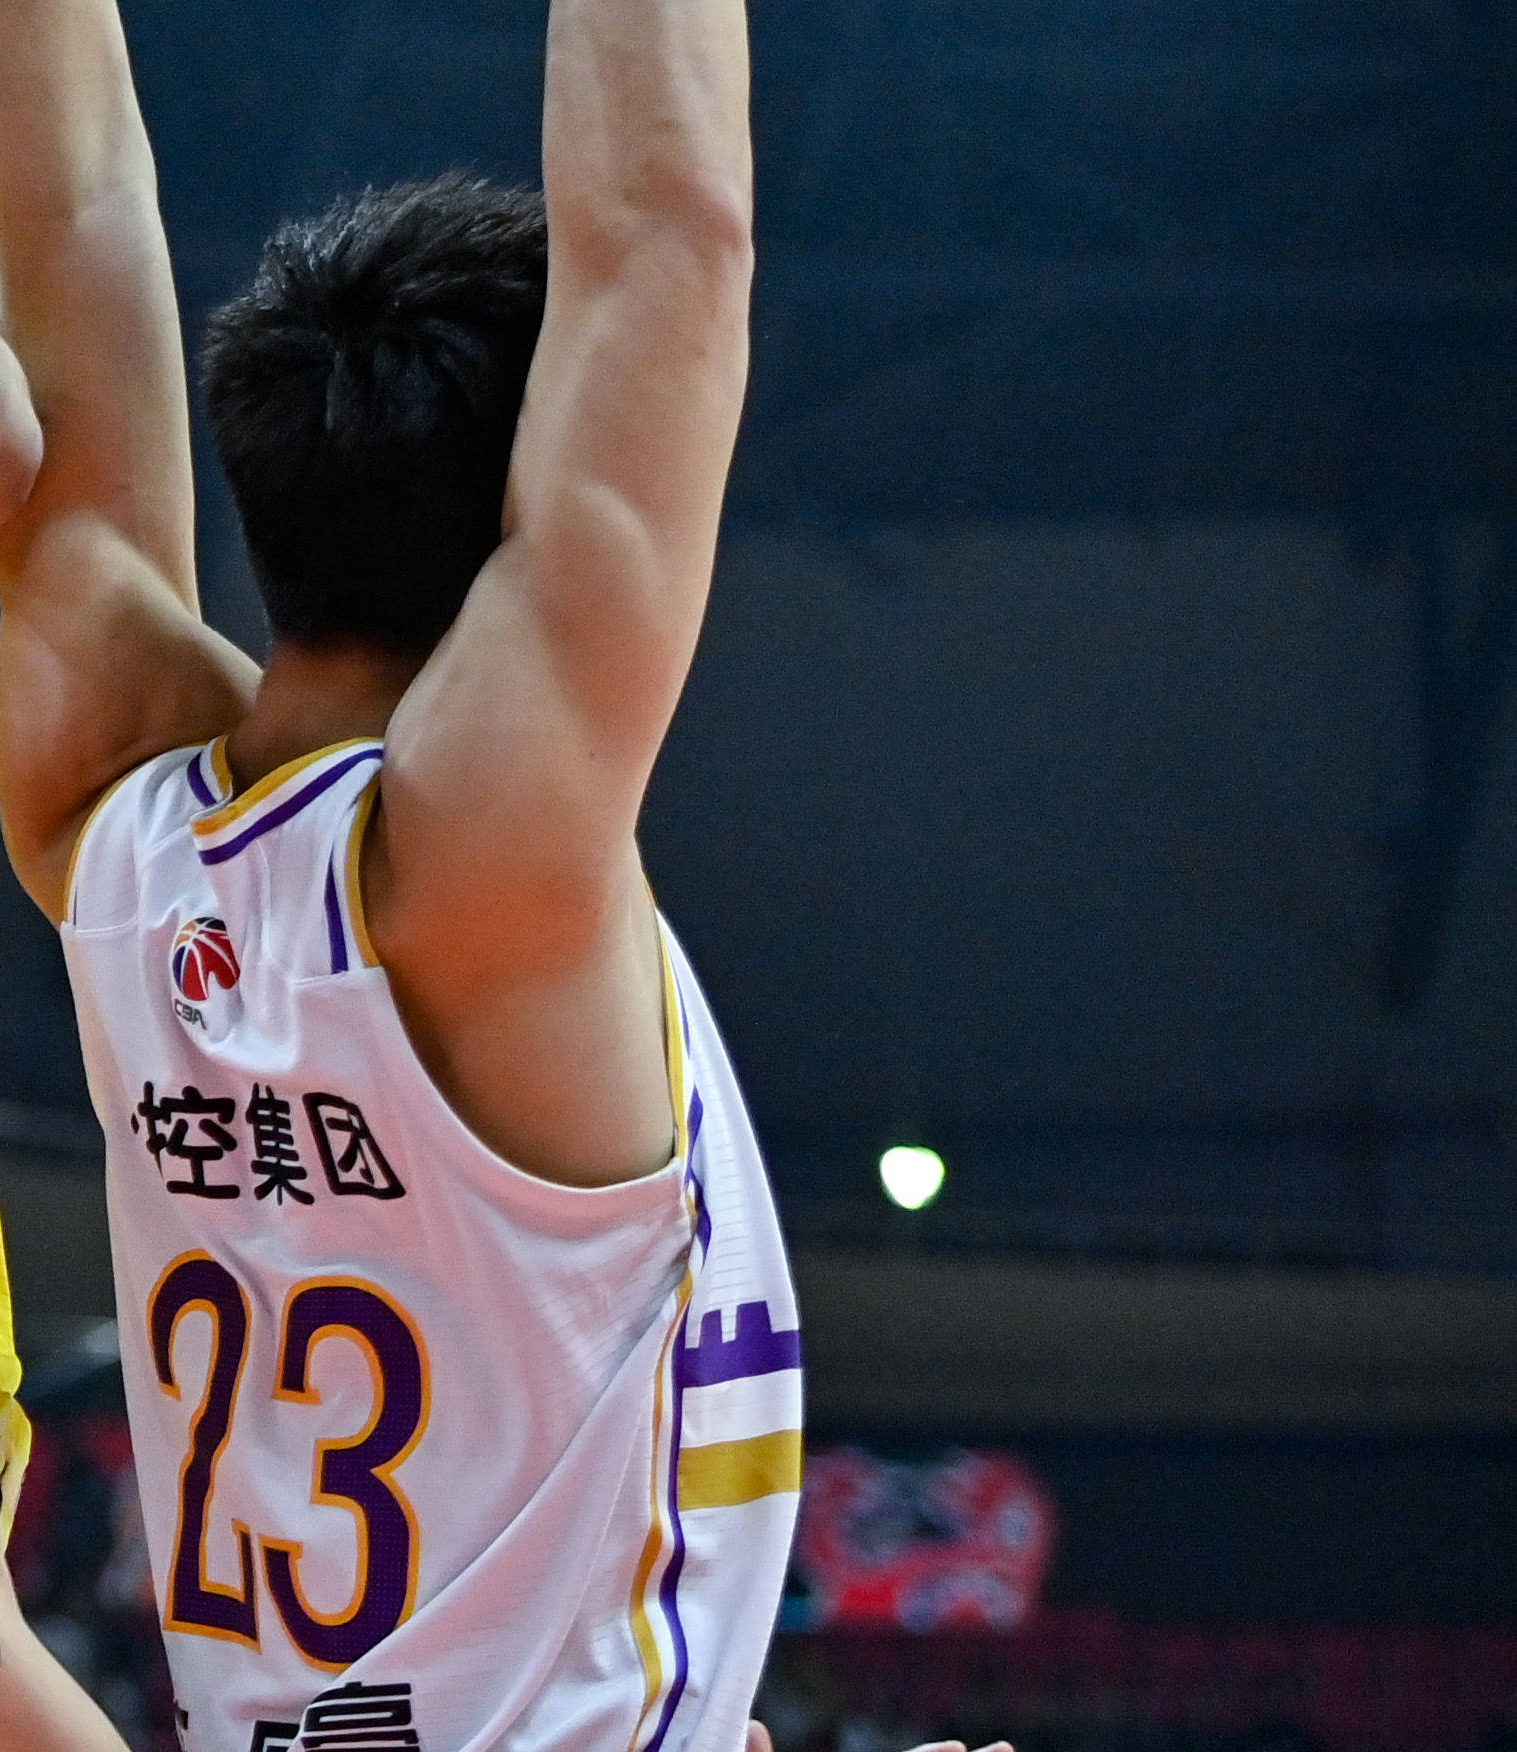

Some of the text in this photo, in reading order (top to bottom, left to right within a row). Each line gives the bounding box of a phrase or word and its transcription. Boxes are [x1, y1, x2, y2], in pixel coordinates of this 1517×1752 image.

[174, 997, 207, 1030] CBA
[130, 1080, 407, 1206] 控集团
[147, 1248, 431, 1672] 23
